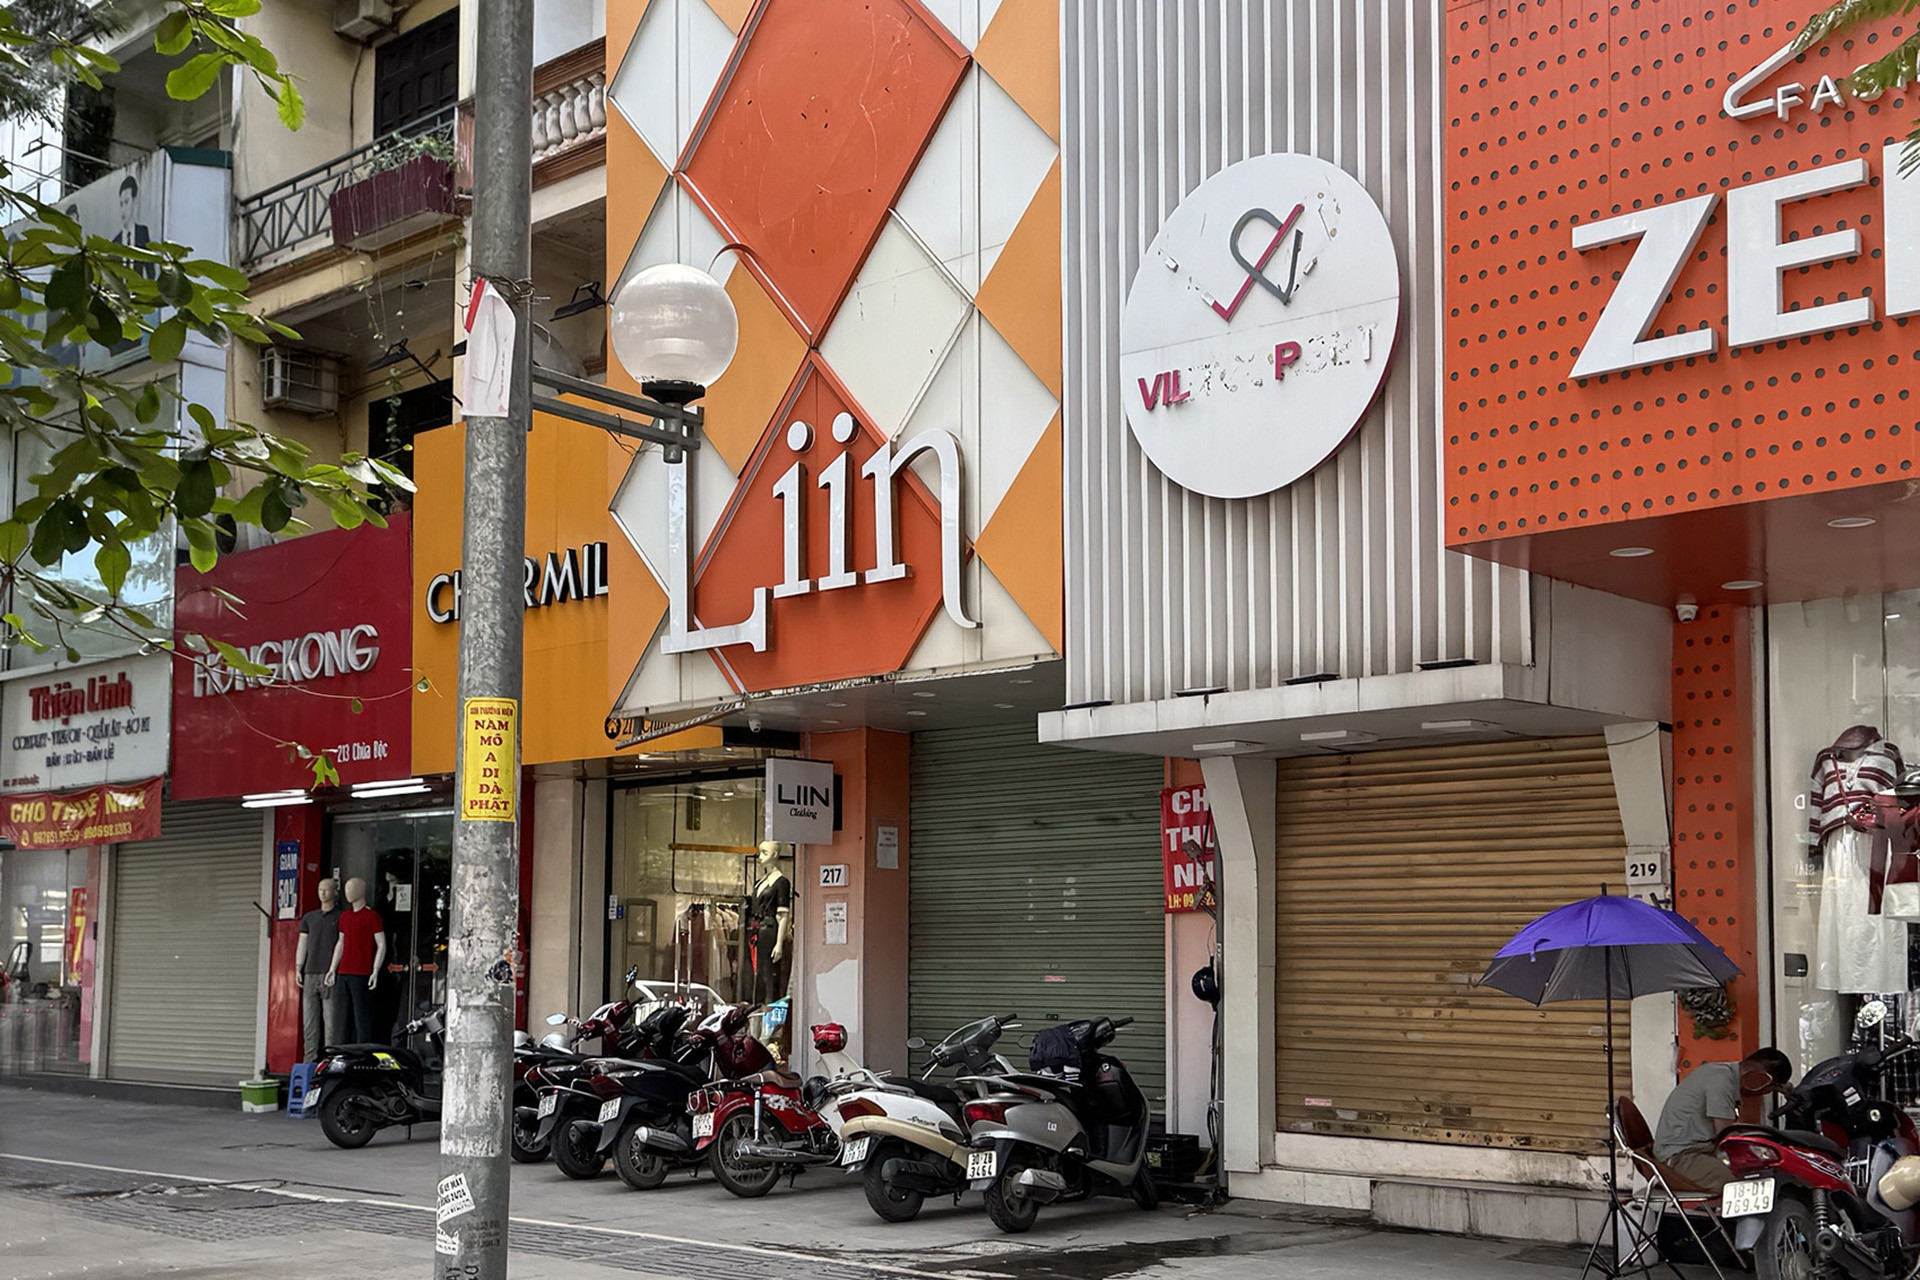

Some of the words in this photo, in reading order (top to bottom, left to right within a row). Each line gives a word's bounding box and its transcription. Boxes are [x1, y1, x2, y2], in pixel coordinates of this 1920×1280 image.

[426, 541, 609, 624] CRMIL
[87, 672, 133, 713] Linh
[474, 719, 509, 731] NAM
[480, 733, 503, 747] MÔ
[337, 743, 350, 763] 213
[485, 751, 497, 763] A
[482, 767, 499, 779] DI
[479, 781, 503, 795] ĐÀ
[777, 783, 830, 808] LIIN
[469, 797, 510, 813] PHẬT
[1171, 788, 1210, 815] CH
[11, 801, 47, 823] CHO
[822, 868, 842, 884] 217
[1630, 863, 1657, 877] 219
[278, 877, 297, 908] 50%
